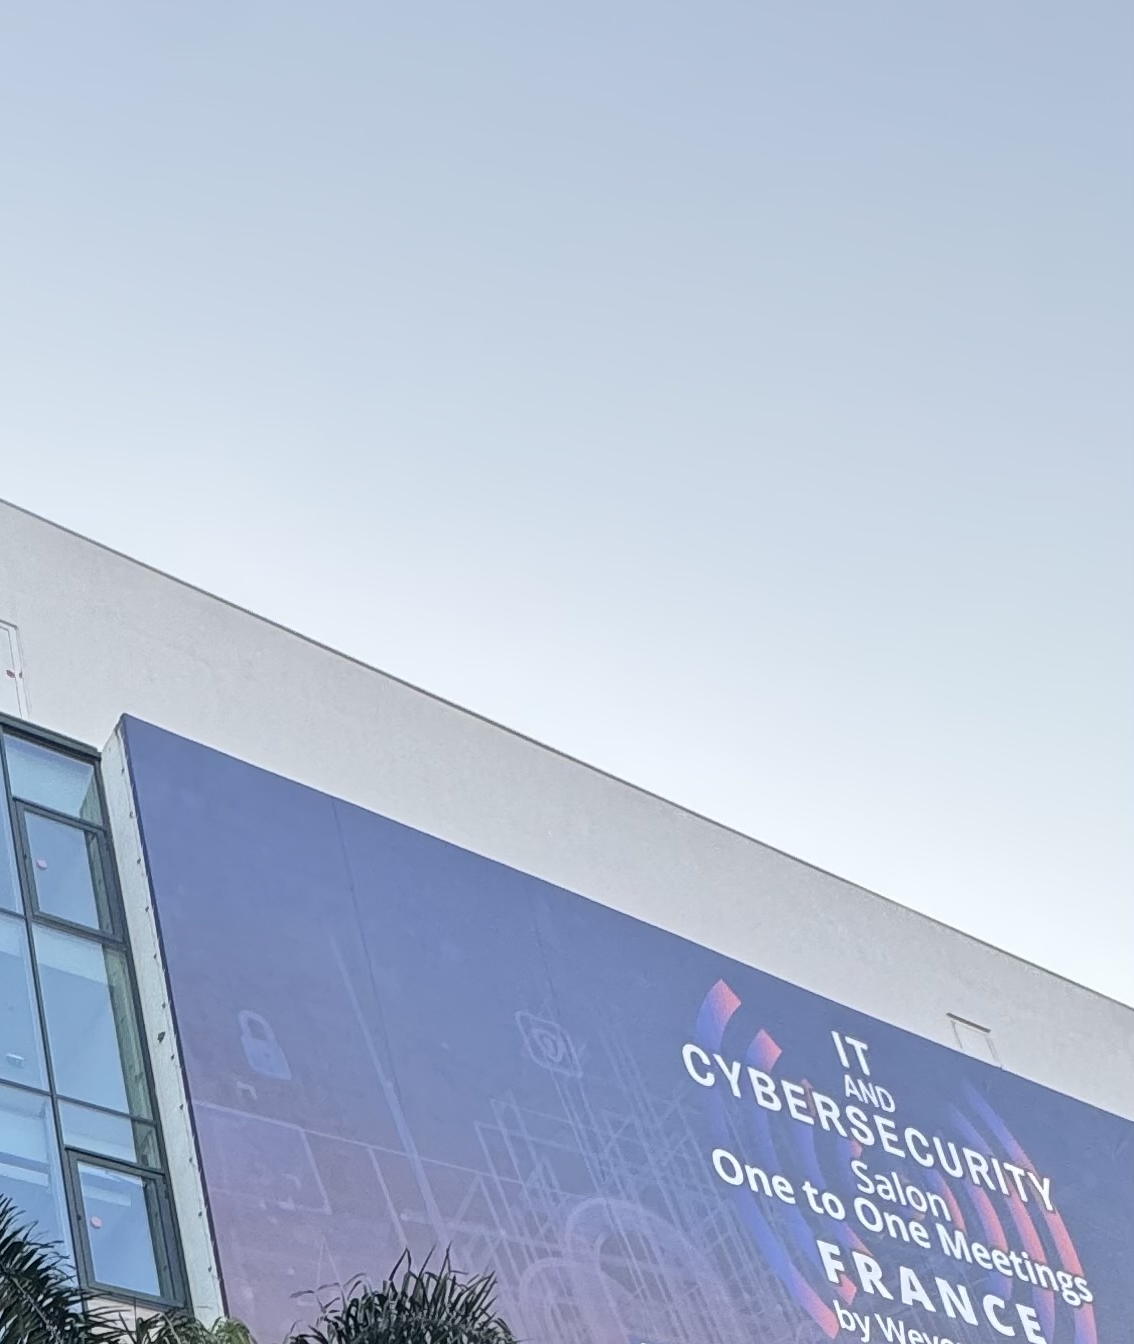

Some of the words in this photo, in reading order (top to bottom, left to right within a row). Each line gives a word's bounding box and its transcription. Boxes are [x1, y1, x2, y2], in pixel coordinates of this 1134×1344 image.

[831, 1030, 871, 1077] IT
[843, 1073, 896, 1114] AND
[681, 1043, 1054, 1212] CYBERSECURITY
[850, 1159, 951, 1222] Salon
[711, 1148, 796, 1205] One
[802, 1180, 846, 1221] to
[853, 1197, 932, 1249] One
[935, 1222, 1093, 1307] Meetings
[832, 1299, 871, 1343] by
